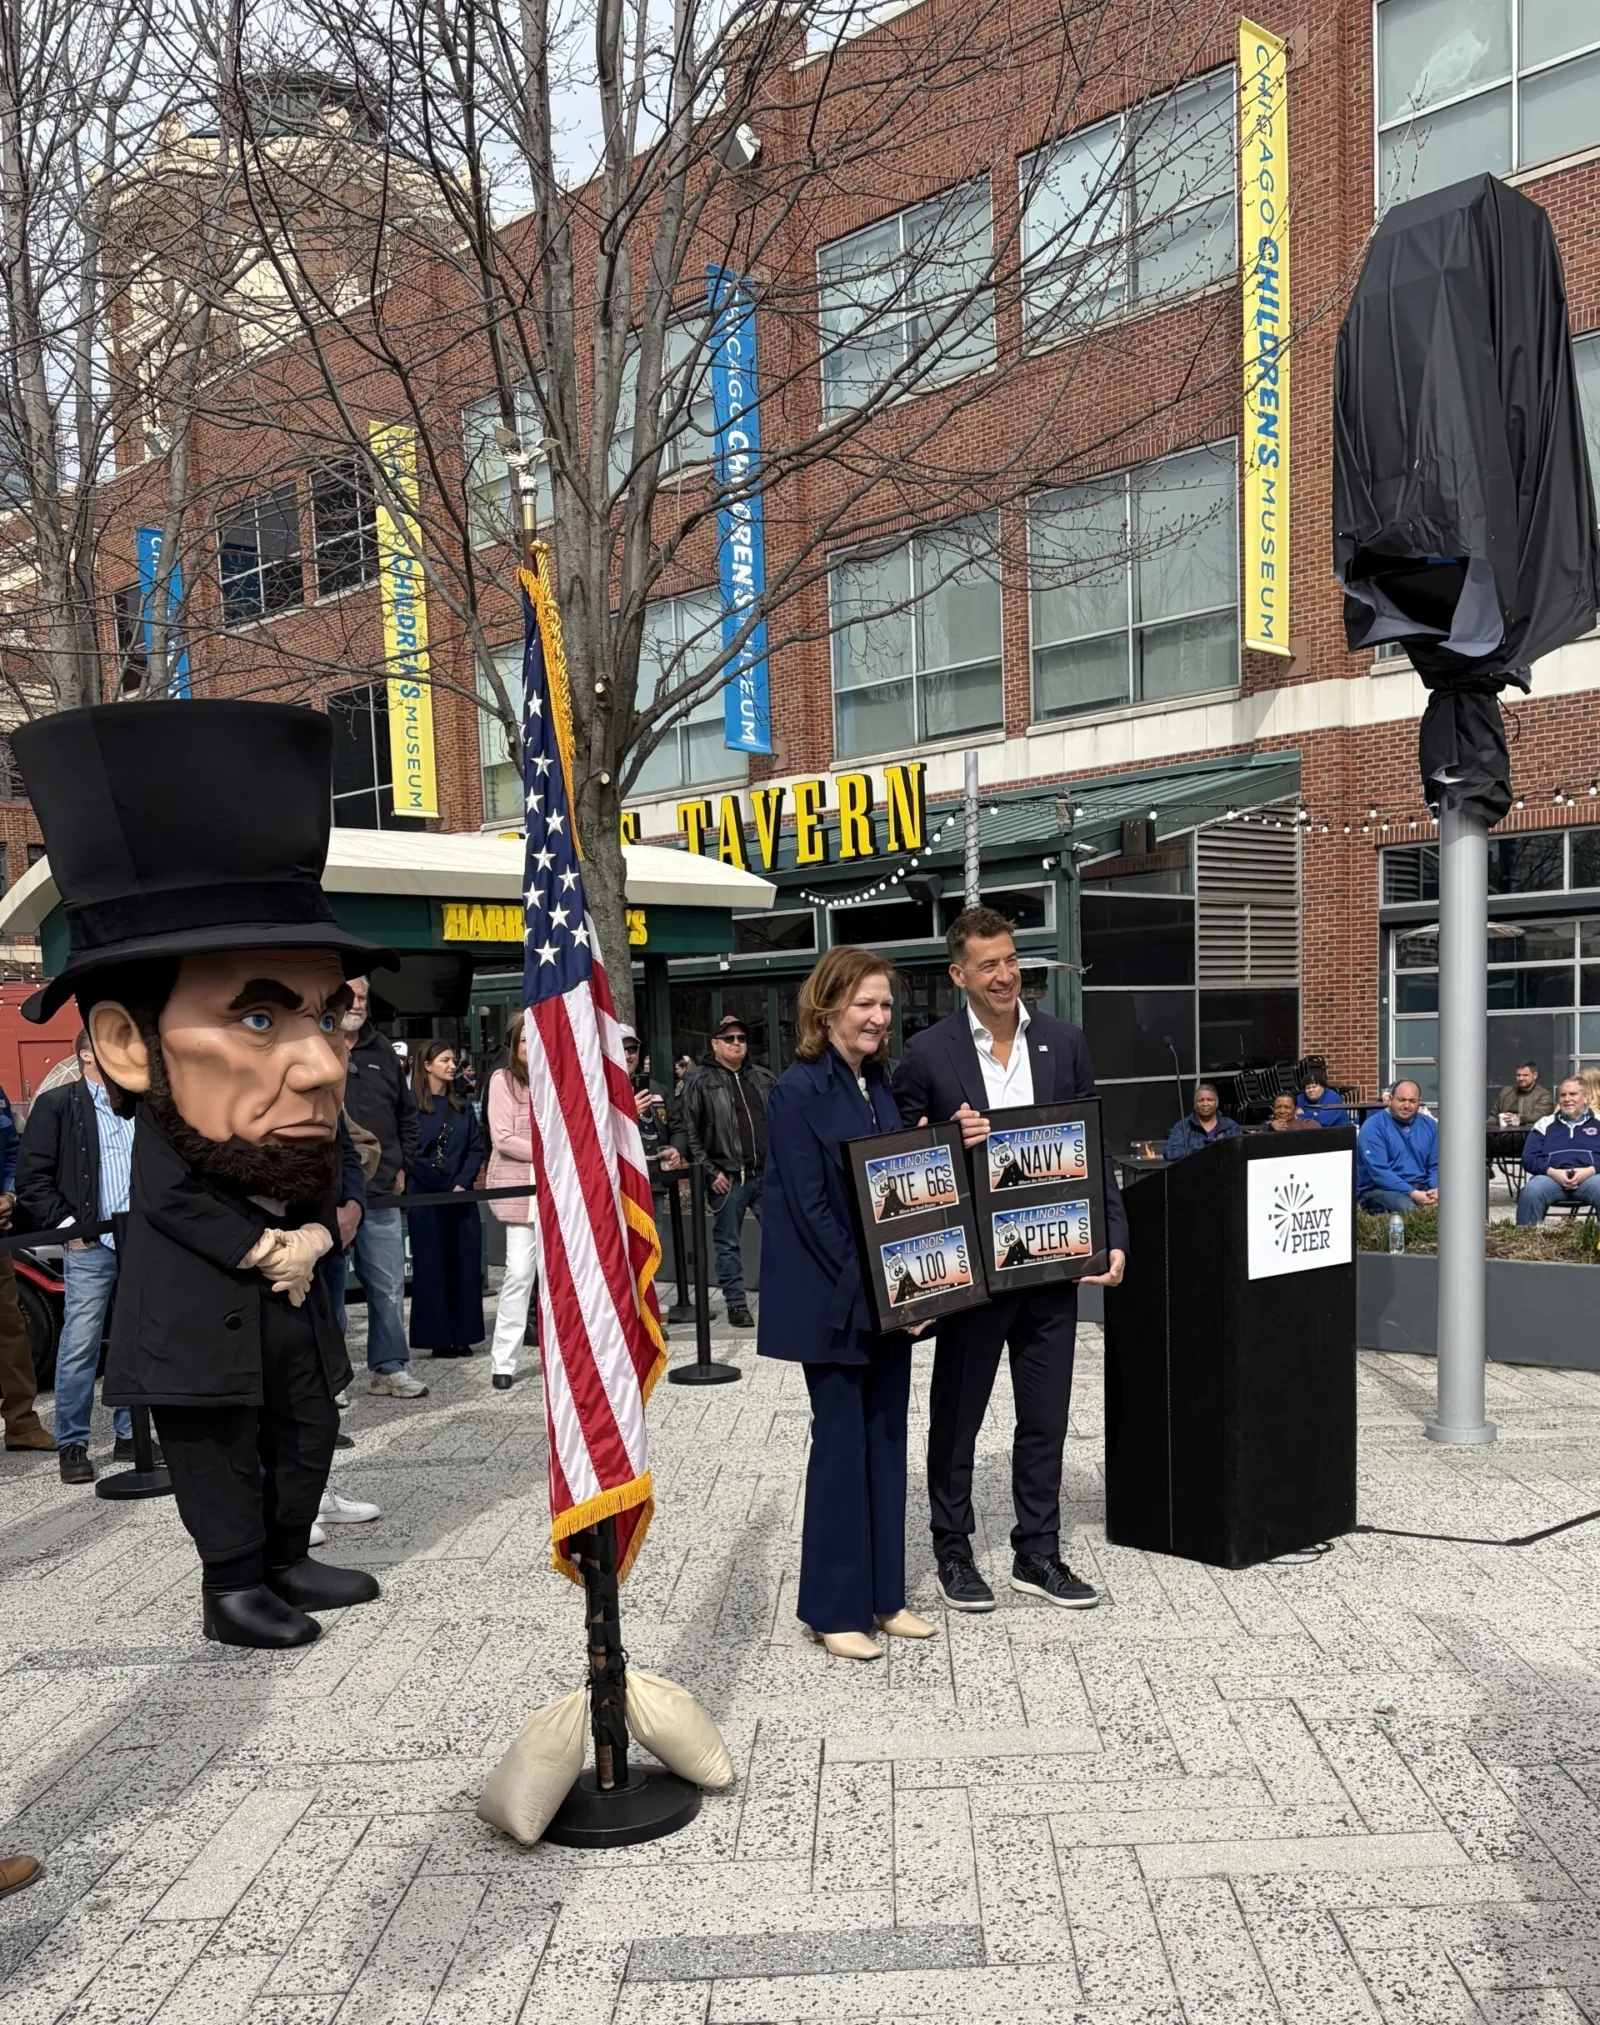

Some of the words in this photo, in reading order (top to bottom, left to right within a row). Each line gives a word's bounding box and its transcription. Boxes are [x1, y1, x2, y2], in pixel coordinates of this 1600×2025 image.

[1256, 44, 1275, 225] CHICAGO
[1256, 236, 1280, 469] CHILDREN'S
[1260, 478, 1276, 639] MUSEUM
[404, 706, 422, 808] MUSEUM
[677, 762, 927, 871] TAVERN
[441, 903, 525, 942] HARR
[1014, 1127, 1061, 1144] ILLINOIS
[1074, 1139, 1083, 1152] S
[890, 1152, 930, 1171] ILLINOIS
[1000, 1153, 1010, 1164] 66
[1020, 1142, 1063, 1174] NAVY
[1075, 1154, 1084, 1167] S
[943, 1164, 951, 1178] S
[945, 1180, 954, 1192] S
[1020, 1206, 1066, 1222] ILLINOIS
[1291, 1208, 1333, 1232] NAVY
[1078, 1217, 1088, 1230] S
[904, 1234, 944, 1254] ILLINOIS
[1005, 1232, 1015, 1244] 66
[1025, 1220, 1069, 1252] PIER
[1079, 1232, 1089, 1244] S
[1291, 1230, 1331, 1254] PIER
[956, 1245, 965, 1259] S
[894, 1266, 903, 1277] 66
[915, 1250, 946, 1285] 100
[959, 1260, 968, 1274] S
